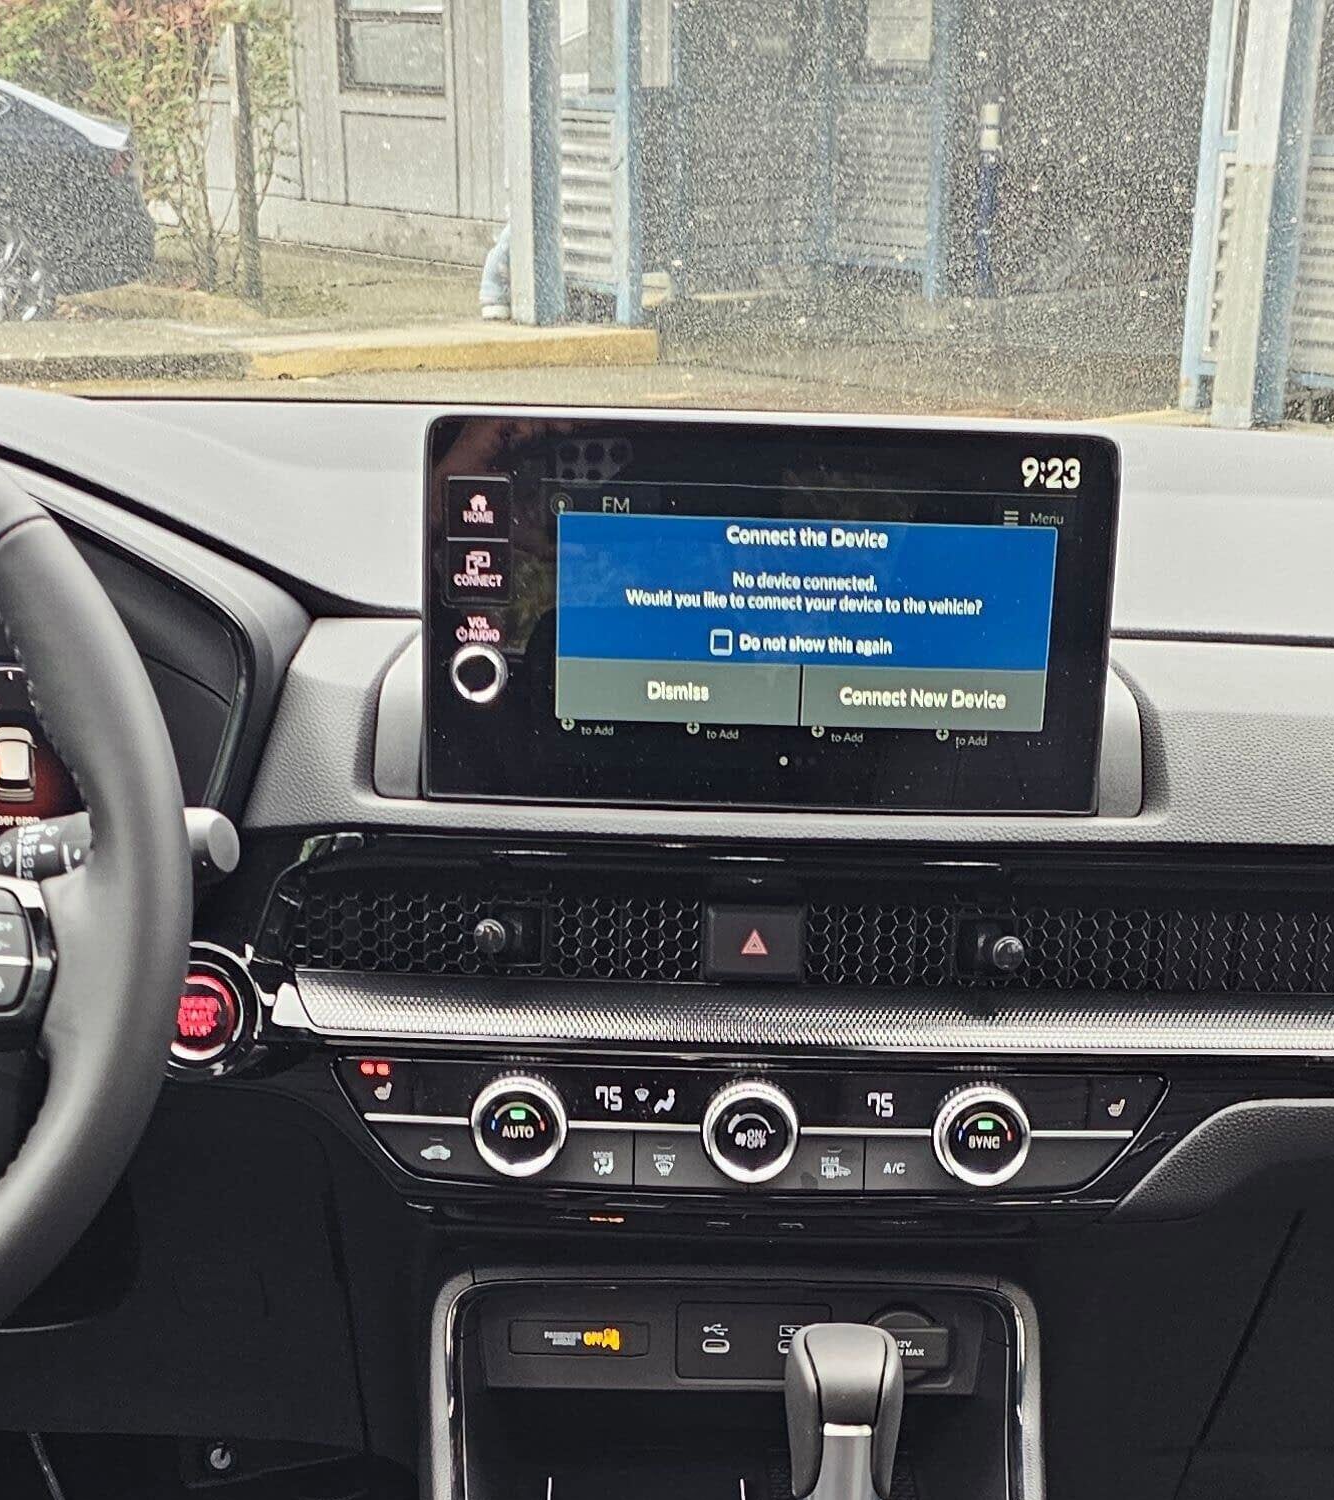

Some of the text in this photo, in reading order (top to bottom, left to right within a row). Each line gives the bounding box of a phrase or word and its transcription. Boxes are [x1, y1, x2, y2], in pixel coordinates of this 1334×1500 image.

[1021, 457, 1081, 489] 9:23
[602, 496, 630, 513] FM
[463, 511, 494, 524] HOME
[1030, 512, 1064, 525] Menu
[726, 525, 888, 549] Connect the Device
[453, 574, 503, 587] CONNECT
[732, 571, 877, 593] No device connected.
[625, 588, 983, 616] Would you like to connect your device to the vehicle?
[467, 616, 489, 628] VOL
[468, 628, 500, 642] AUDIO
[739, 633, 893, 657] Do not show this again
[647, 680, 710, 702] Dismiss
[839, 686, 1007, 710] Connect New Device
[581, 726, 614, 736] to Add
[706, 729, 739, 740] to Add
[831, 732, 863, 743] to Add
[955, 736, 988, 746] to Add
[15, 816, 41, 828] open
[595, 1086, 623, 1111] 75
[867, 1092, 894, 1118] 75
[502, 1125, 534, 1140] AUTO
[968, 1135, 1001, 1149] SYNC
[653, 1154, 676, 1162] FRONT
[883, 1162, 906, 1174] A/C
